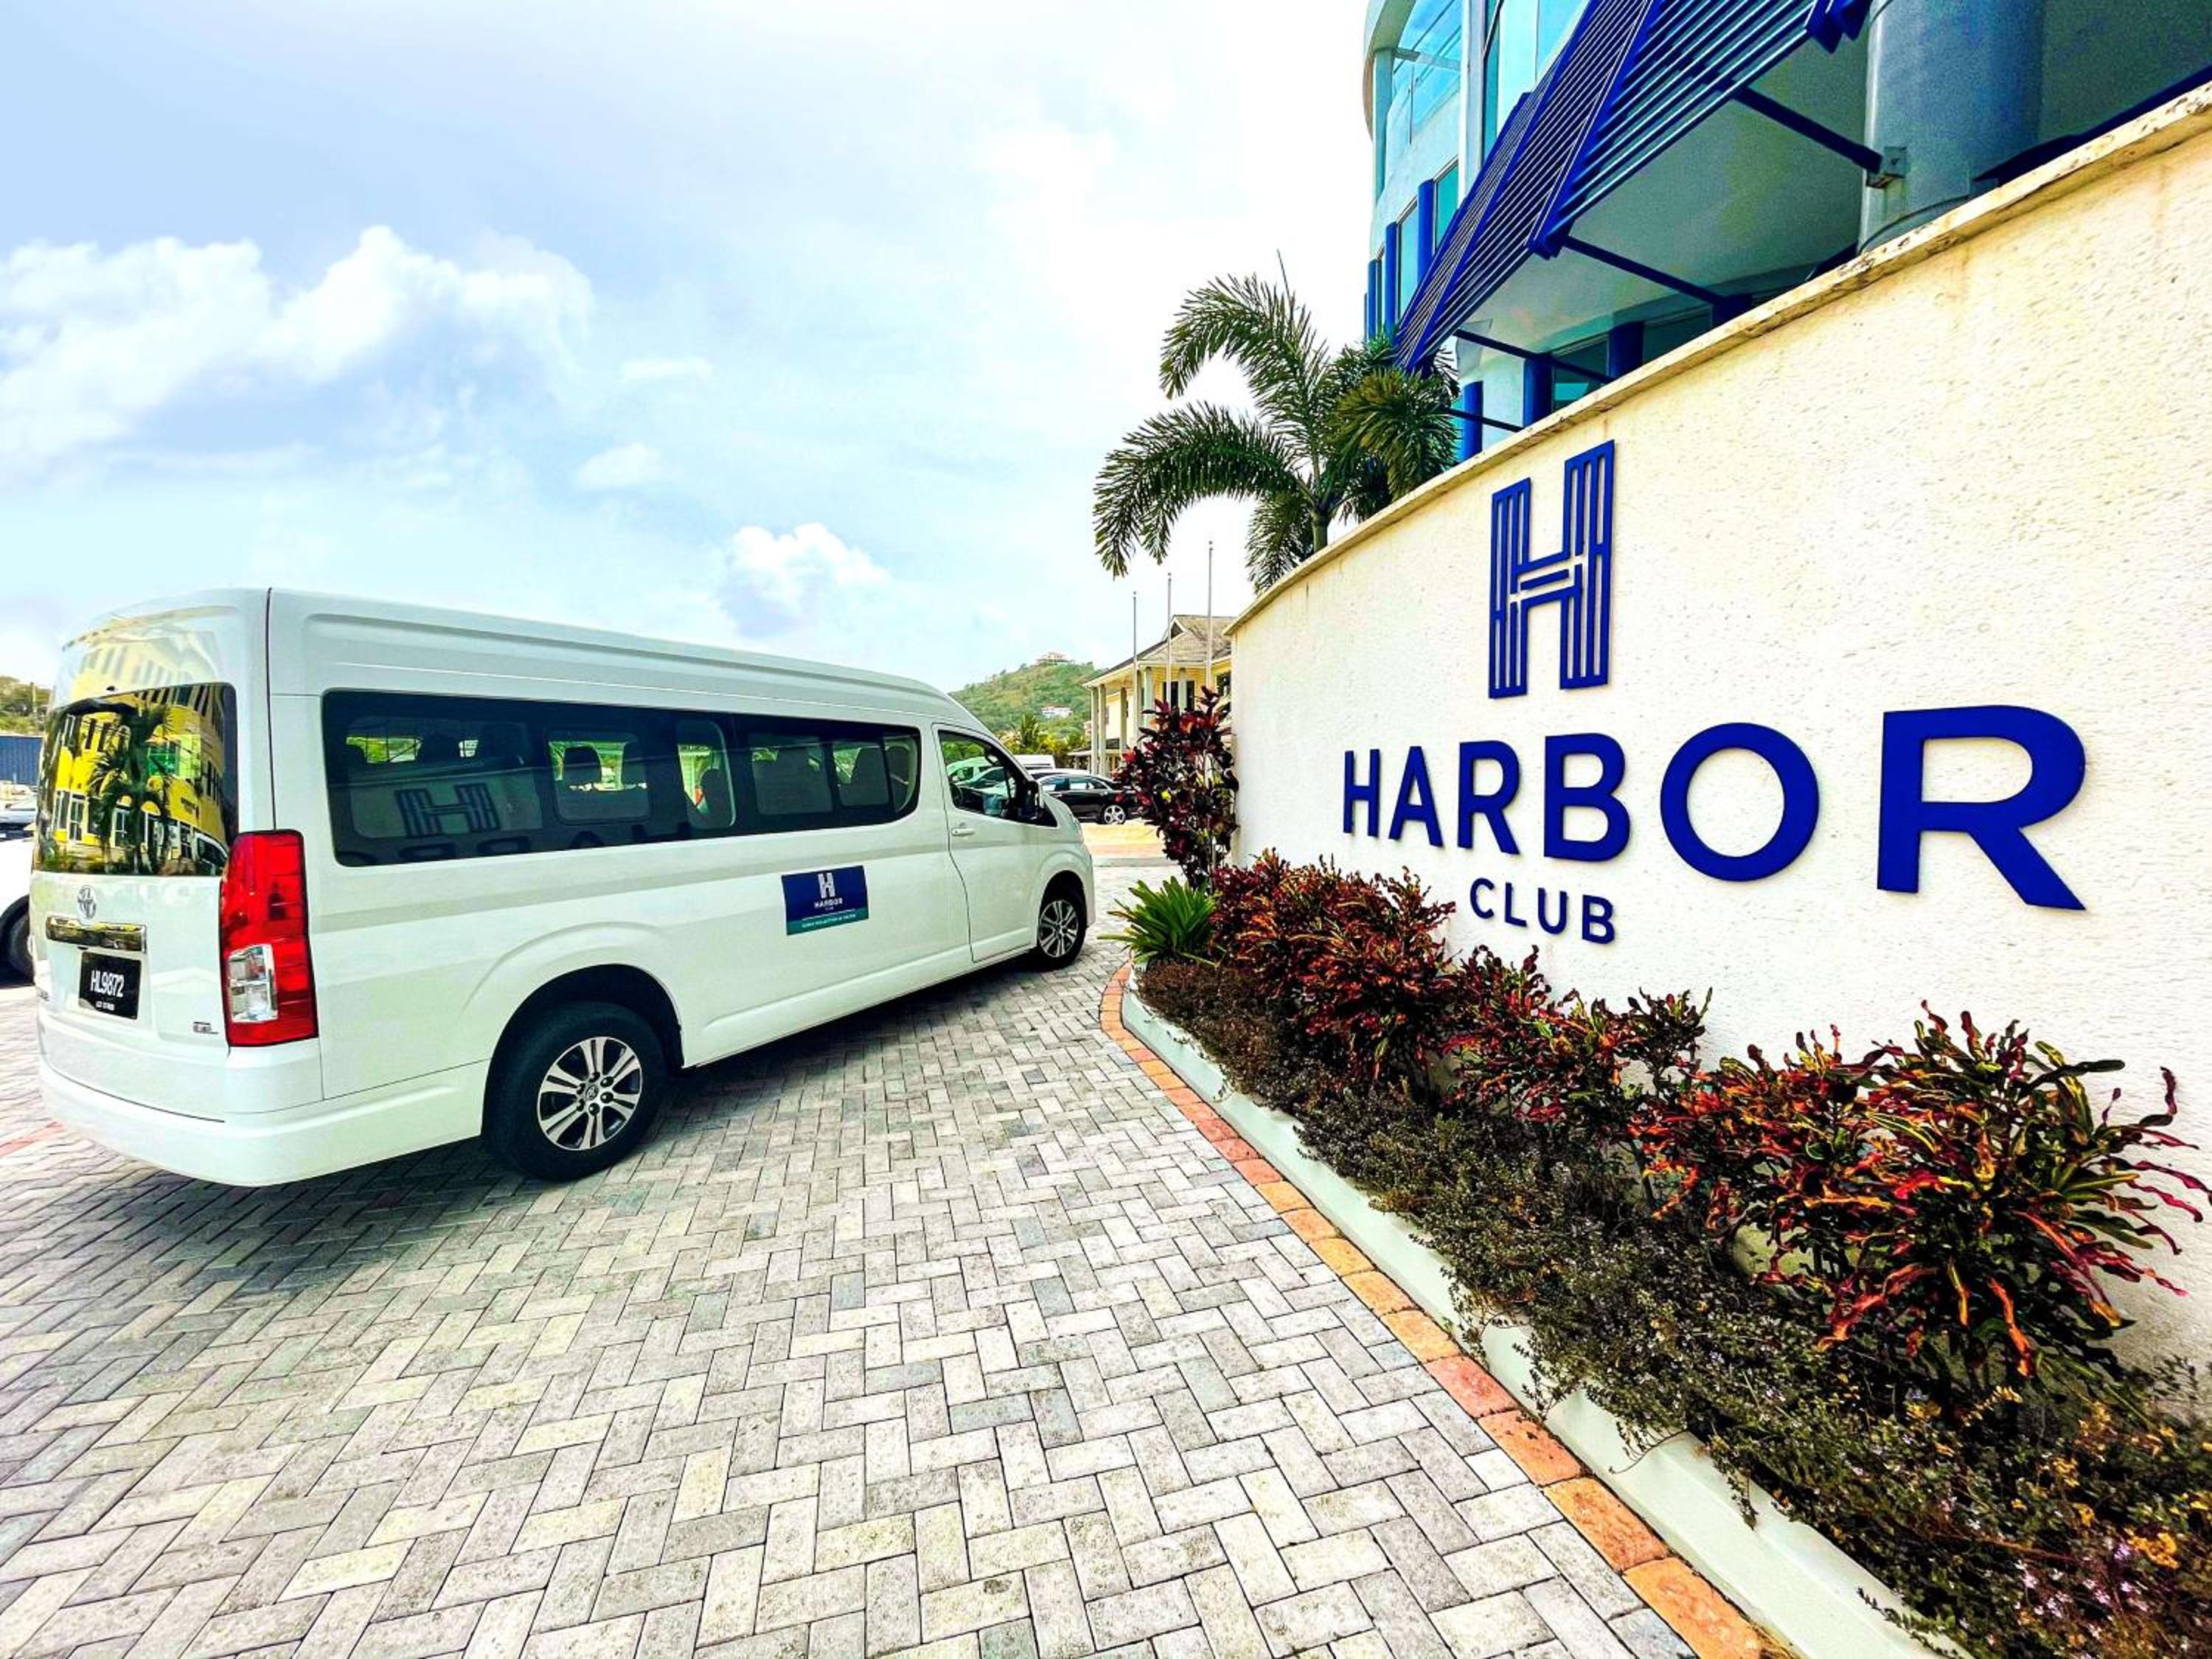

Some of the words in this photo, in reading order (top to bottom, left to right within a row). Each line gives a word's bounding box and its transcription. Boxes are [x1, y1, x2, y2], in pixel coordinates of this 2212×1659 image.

[1488, 440, 1615, 698] H
[1343, 705, 2087, 911] HARBOR
[813, 897, 843, 909] HARBOR
[818, 872, 835, 898] H
[1470, 877, 1615, 945] CLUB
[90, 970, 125, 998] HL9872
